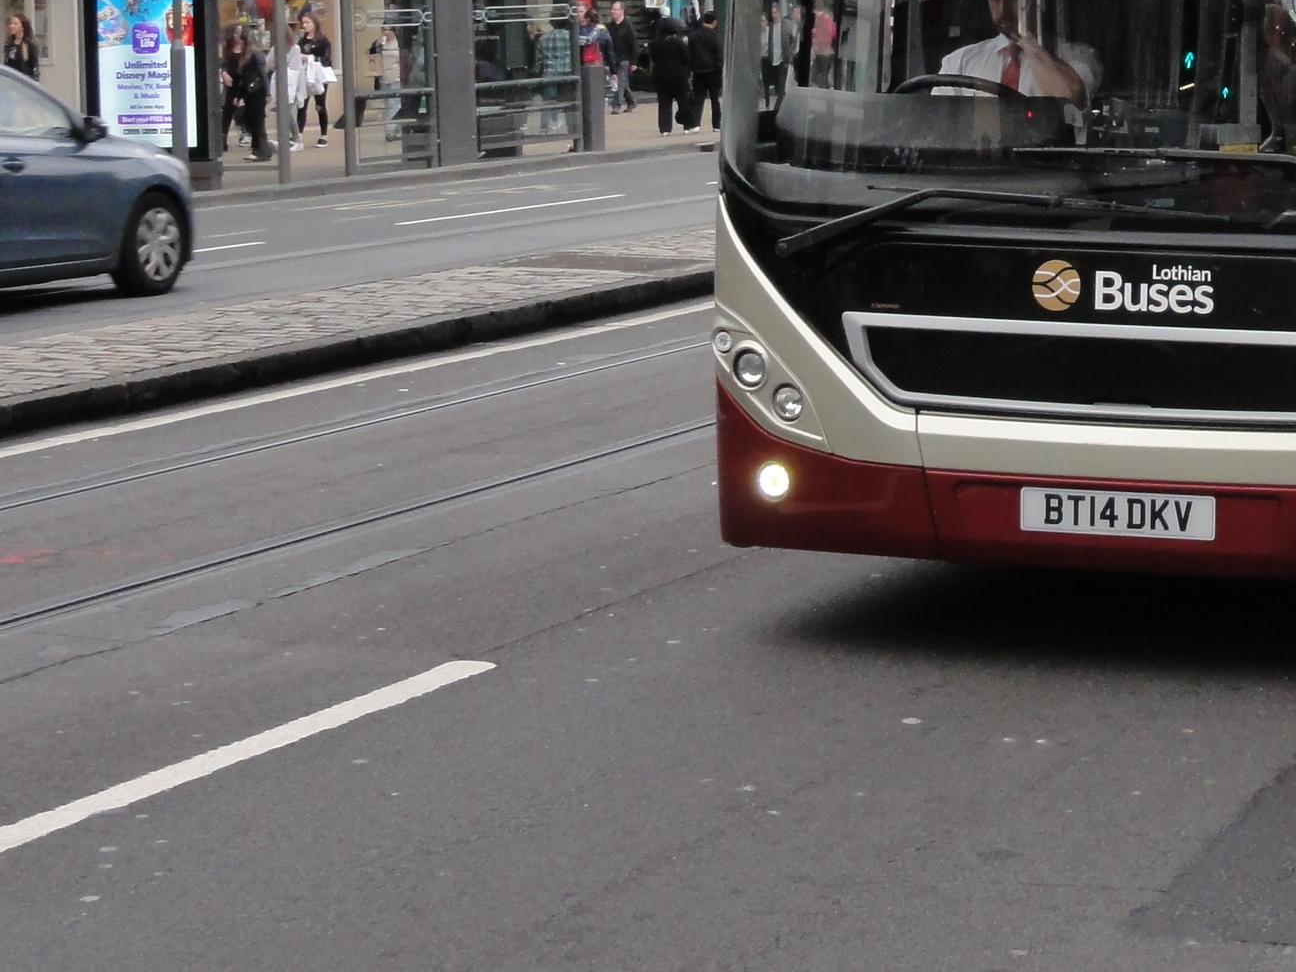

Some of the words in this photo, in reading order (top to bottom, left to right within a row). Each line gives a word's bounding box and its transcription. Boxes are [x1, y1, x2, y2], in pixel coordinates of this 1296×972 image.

[140, 38, 155, 48] Life
[124, 60, 168, 69] Unlimited
[116, 71, 146, 81] Disney
[148, 71, 171, 81] Magi
[1152, 264, 1211, 282] Lothian
[1094, 270, 1214, 315] Buses
[1044, 494, 1119, 529] BT14
[1126, 498, 1193, 532] DKV
